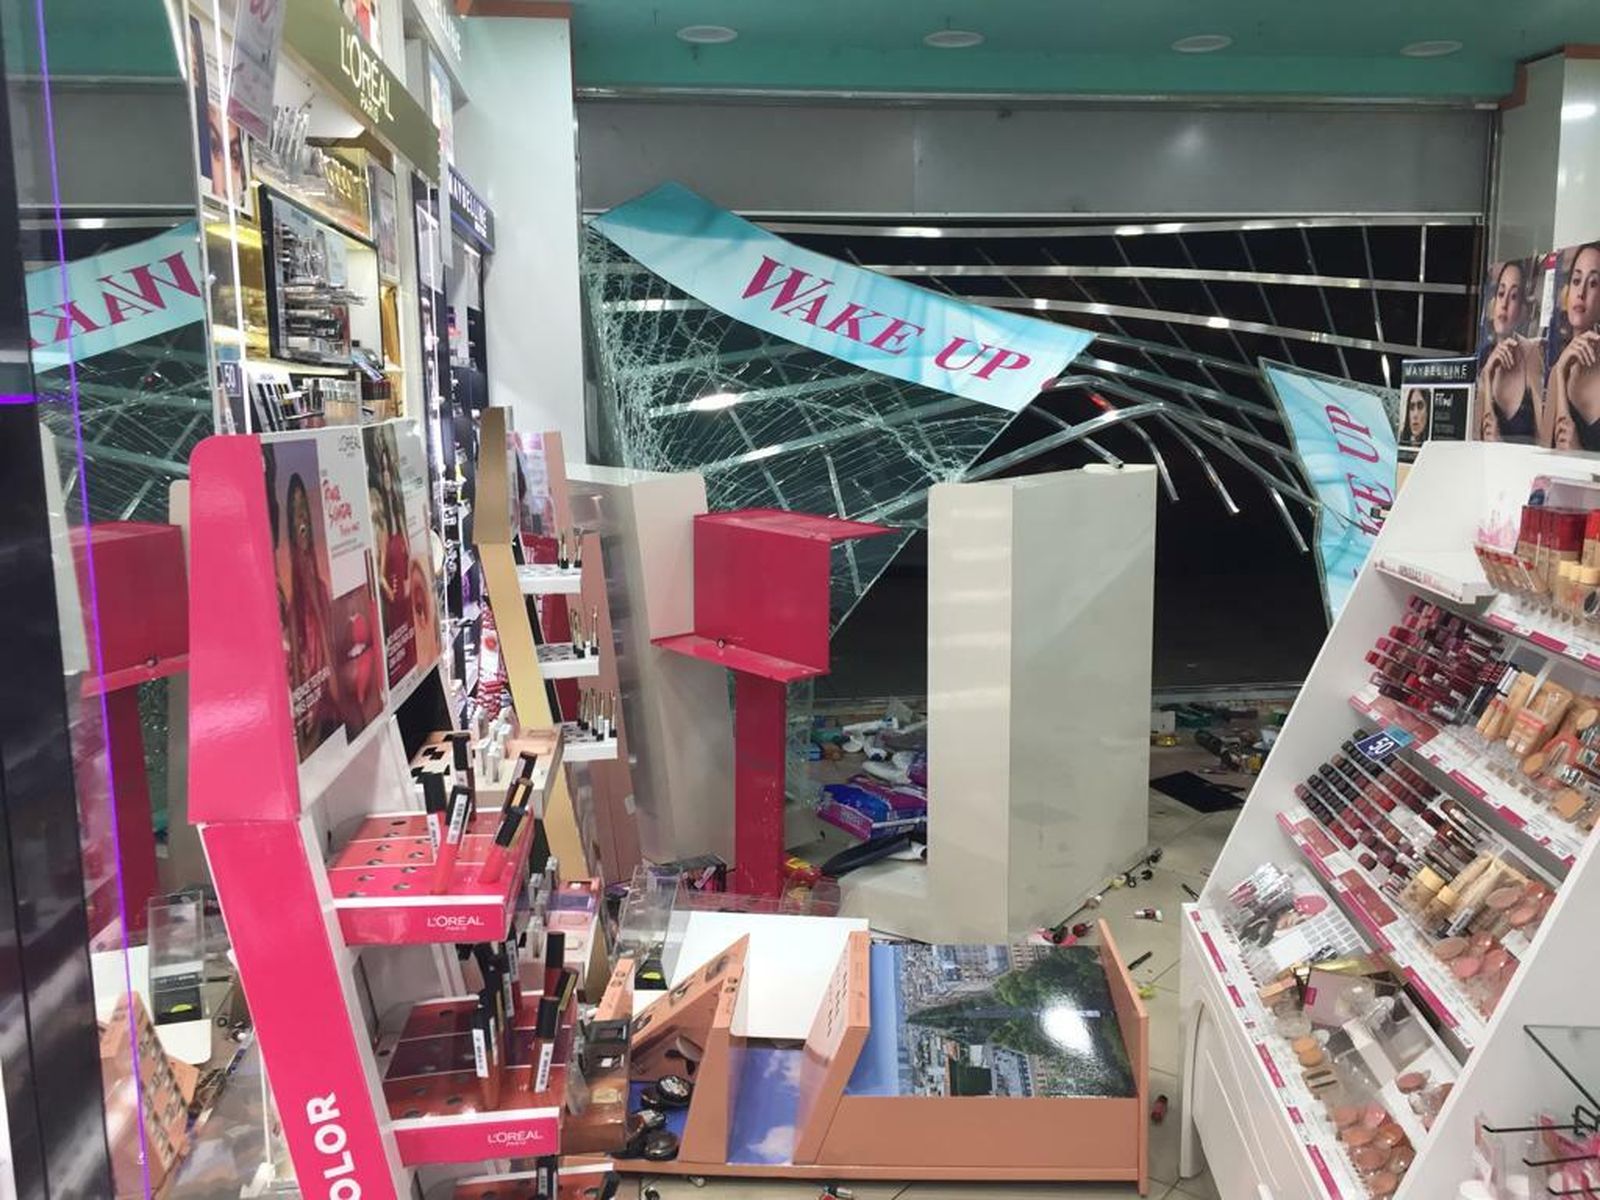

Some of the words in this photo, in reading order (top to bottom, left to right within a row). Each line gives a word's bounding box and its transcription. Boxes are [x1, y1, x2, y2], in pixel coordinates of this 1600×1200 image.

[742, 255, 925, 355] WAKE
[934, 336, 1031, 380] UP
[1405, 364, 1468, 376] MAYBELLINE
[1325, 404, 1380, 464] UP
